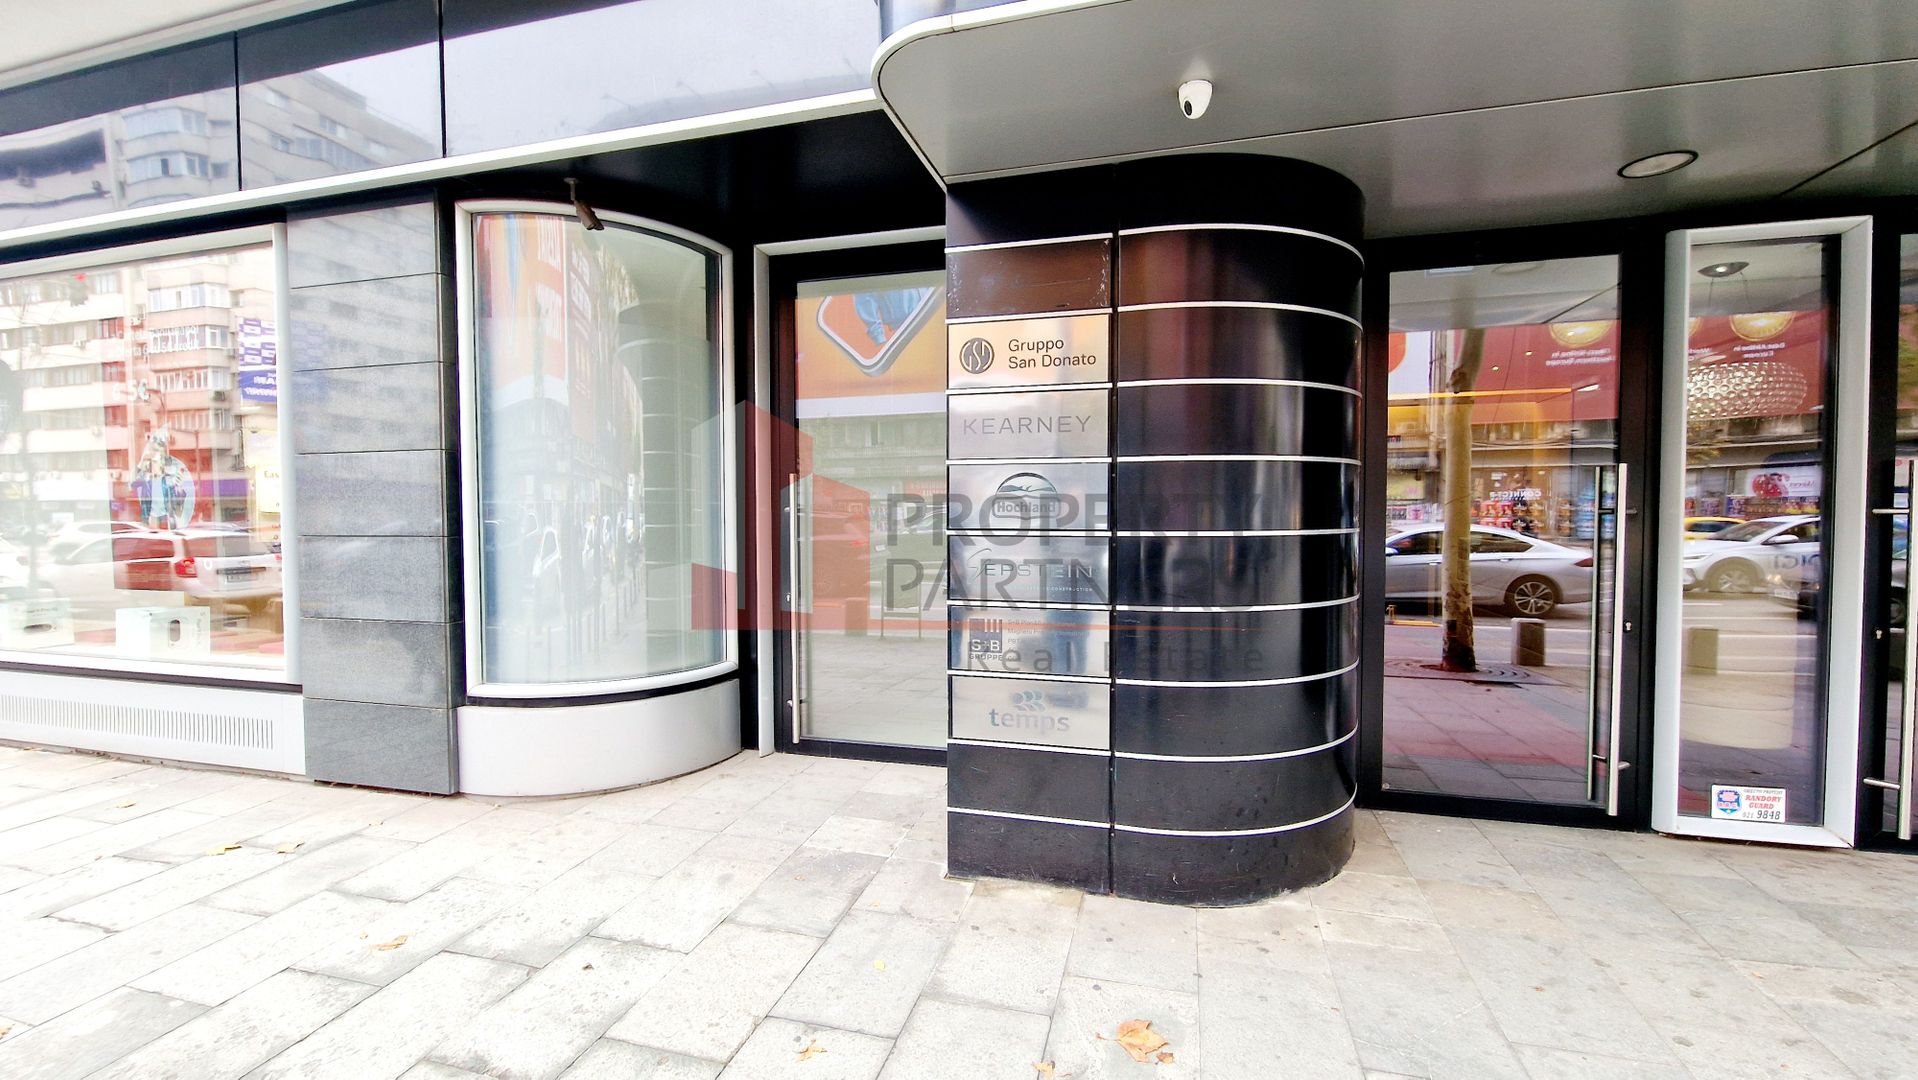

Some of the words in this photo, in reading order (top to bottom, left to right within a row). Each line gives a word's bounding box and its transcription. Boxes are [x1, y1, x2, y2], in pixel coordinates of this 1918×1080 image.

[1008, 339, 1064, 354] Gruppo
[1008, 356, 1036, 369] San
[1041, 354, 1097, 368] Donato
[963, 415, 1091, 435] KEARNEY
[997, 501, 1056, 513] Hochland
[984, 563, 1092, 578] EPSTEIN
[988, 708, 1071, 736] temps
[1757, 810, 1781, 820] 9848
